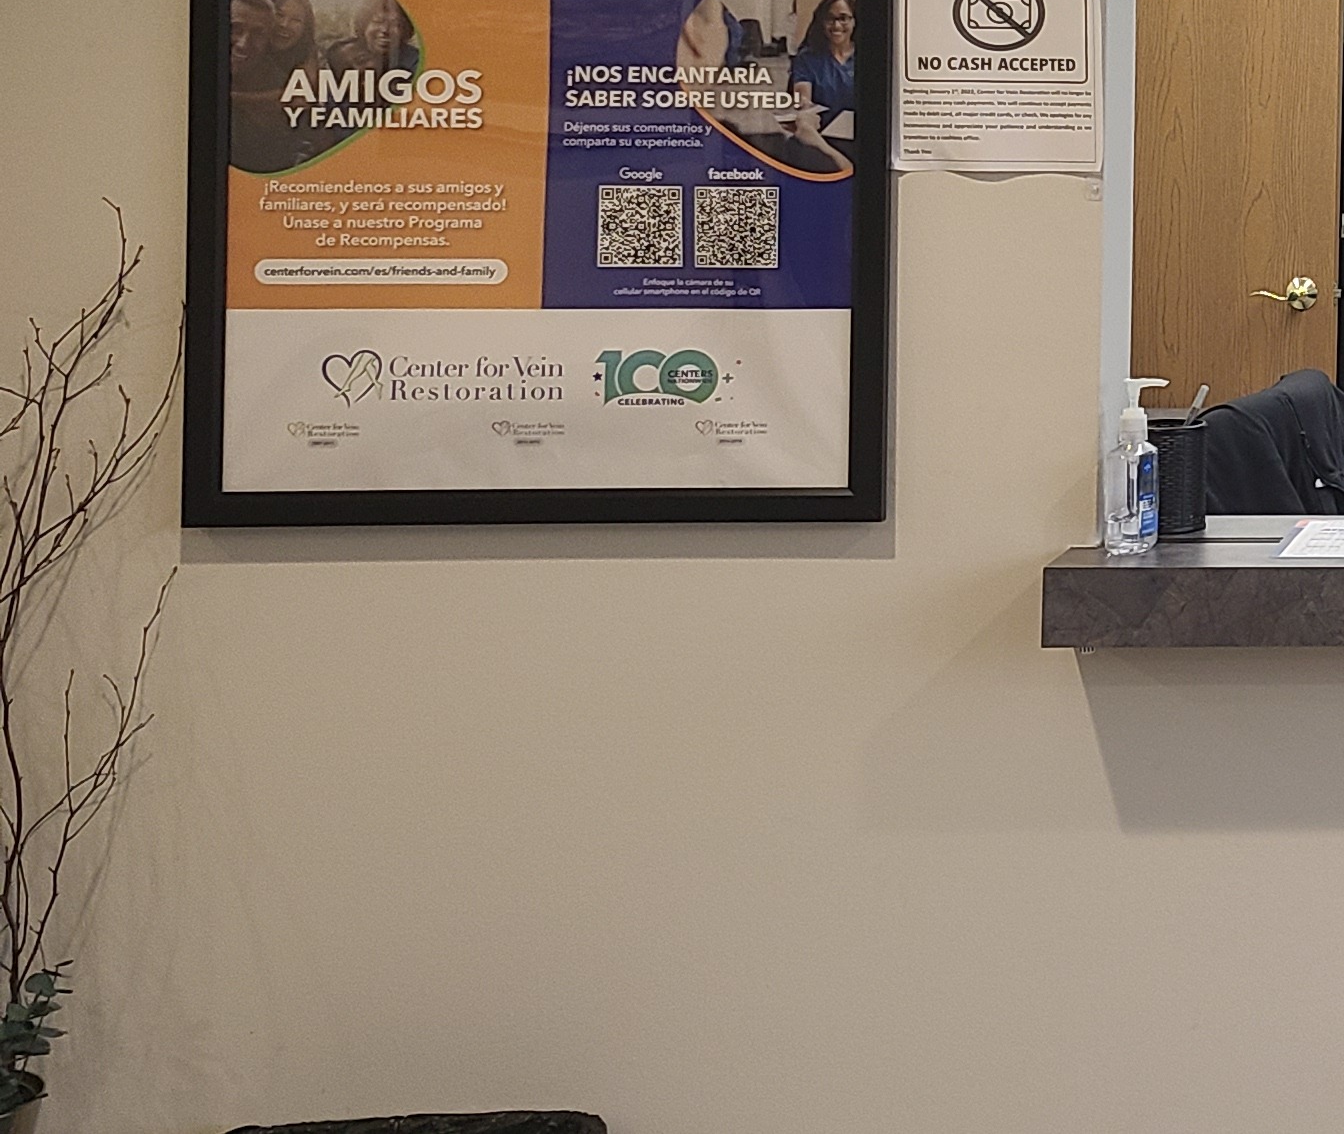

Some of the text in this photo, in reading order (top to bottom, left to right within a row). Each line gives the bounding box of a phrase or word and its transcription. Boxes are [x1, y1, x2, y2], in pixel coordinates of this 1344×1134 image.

[918, 56, 1076, 72] NO CASH ACCEPTED
[567, 63, 772, 87] ¡NOS ENCANTARÍA
[281, 69, 483, 105] AMIGOS
[565, 90, 800, 109] SABER SOBRE USTED!
[284, 108, 483, 129] Y FAMILIARES
[564, 121, 713, 136] Déjenos sus comentarios y
[563, 137, 703, 149] comparta su experiencia.
[619, 167, 663, 181] Google
[708, 169, 764, 180] facebook
[395, 184, 404, 193] a
[408, 184, 433, 193] sus
[436, 182, 491, 196] amigos
[494, 185, 504, 196] y
[259, 198, 506, 214] familiares, y será recompensado!
[283, 215, 482, 231] Únase a nuestro Programa
[316, 235, 449, 249] de Recompensas.
[264, 266, 496, 280] centerforvein.com/es/friends-and-family
[389, 356, 564, 378] Center for Vein
[668, 370, 713, 378] CENTERS
[390, 379, 564, 401] Restoration
[618, 397, 685, 407] CELEBRATING
